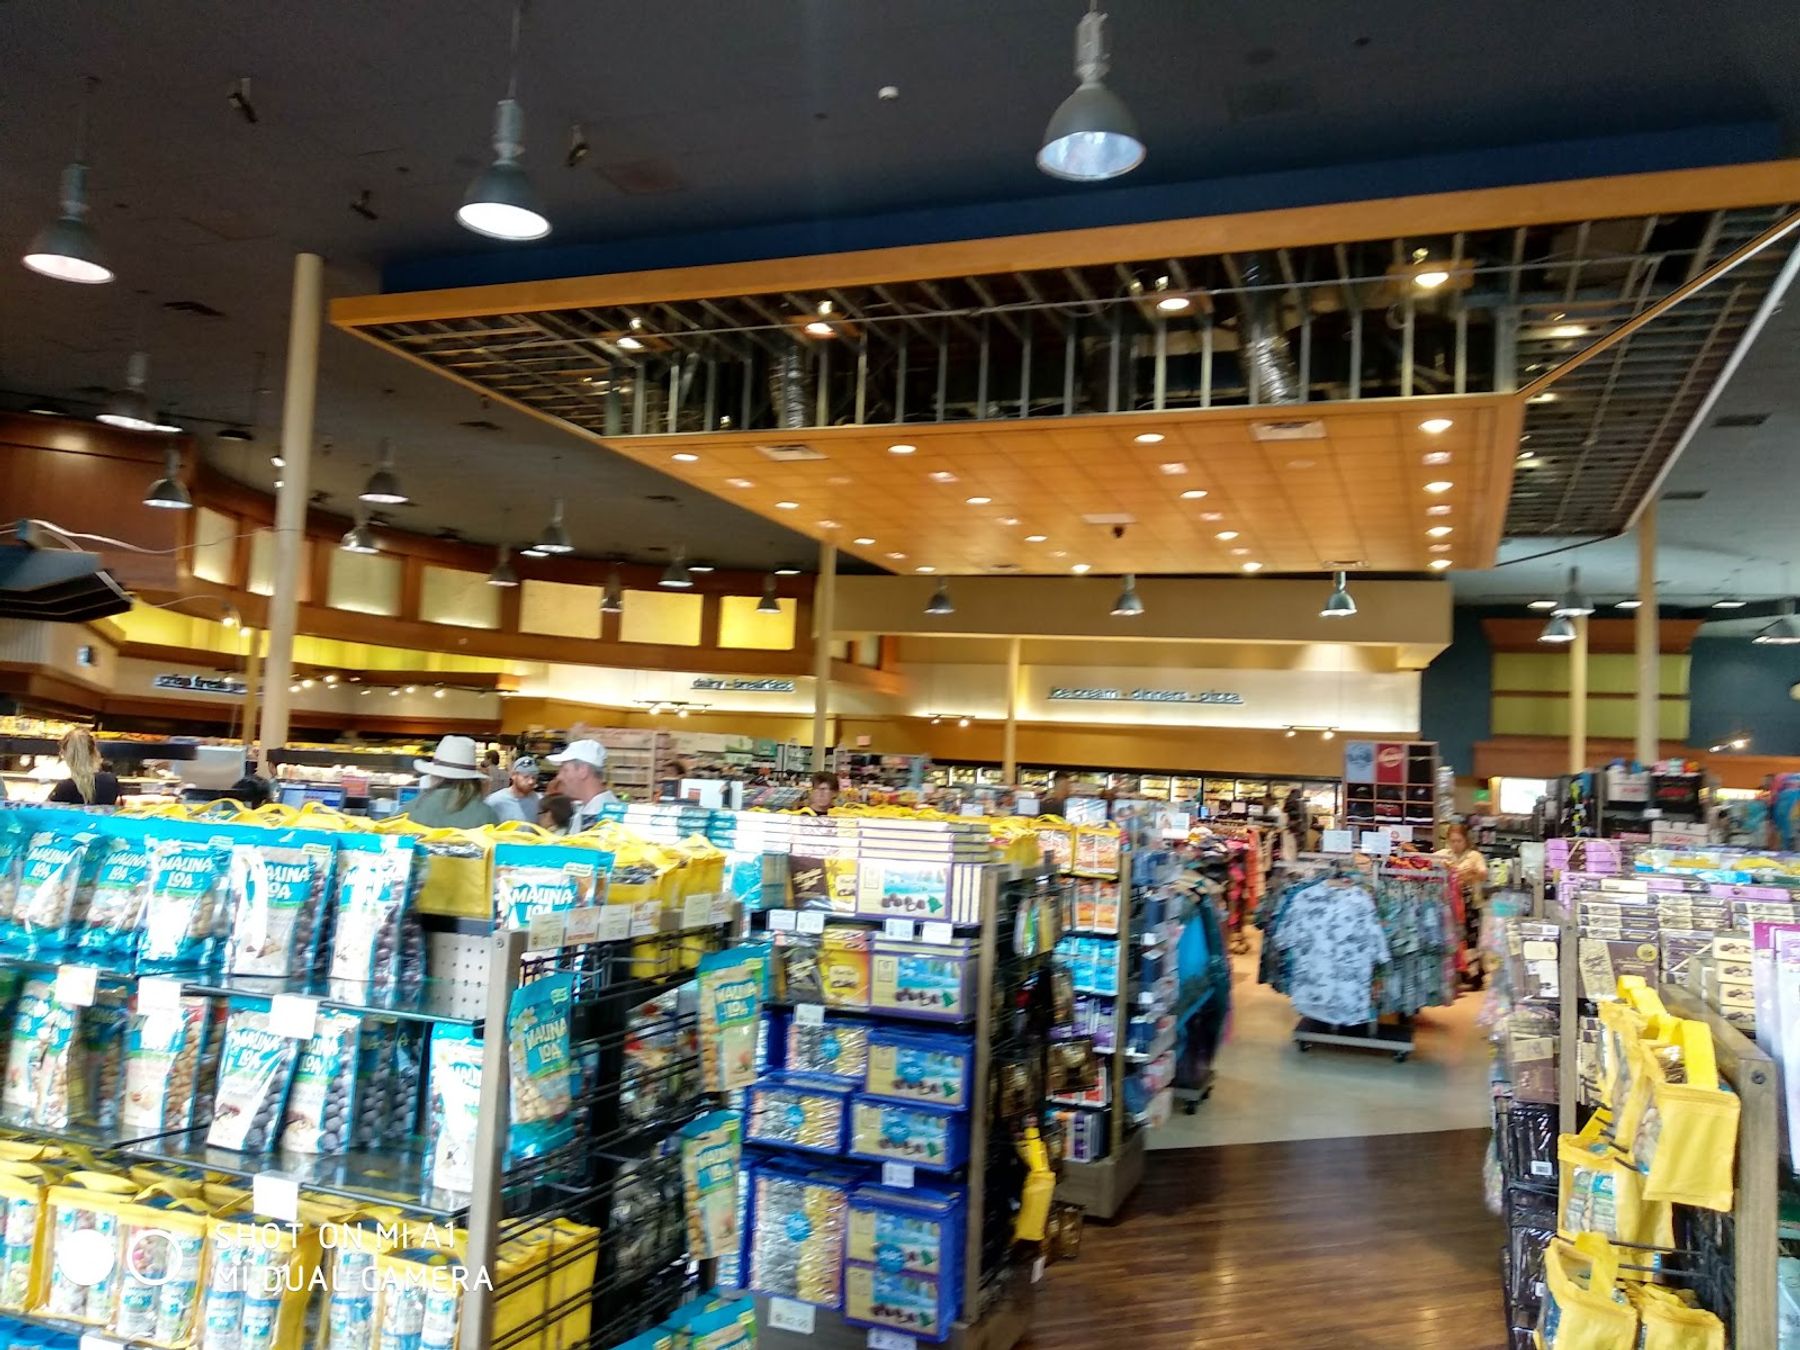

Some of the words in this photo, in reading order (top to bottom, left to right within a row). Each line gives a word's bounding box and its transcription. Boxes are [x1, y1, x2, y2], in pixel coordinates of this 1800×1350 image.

[157, 855, 213, 873] MAUNA
[264, 863, 312, 883] AUNA
[167, 871, 194, 889] LOA
[267, 882, 293, 900] OA
[511, 886, 574, 906] MAUNA
[526, 1017, 568, 1051] MAUNA
[538, 1042, 563, 1064] LOA
